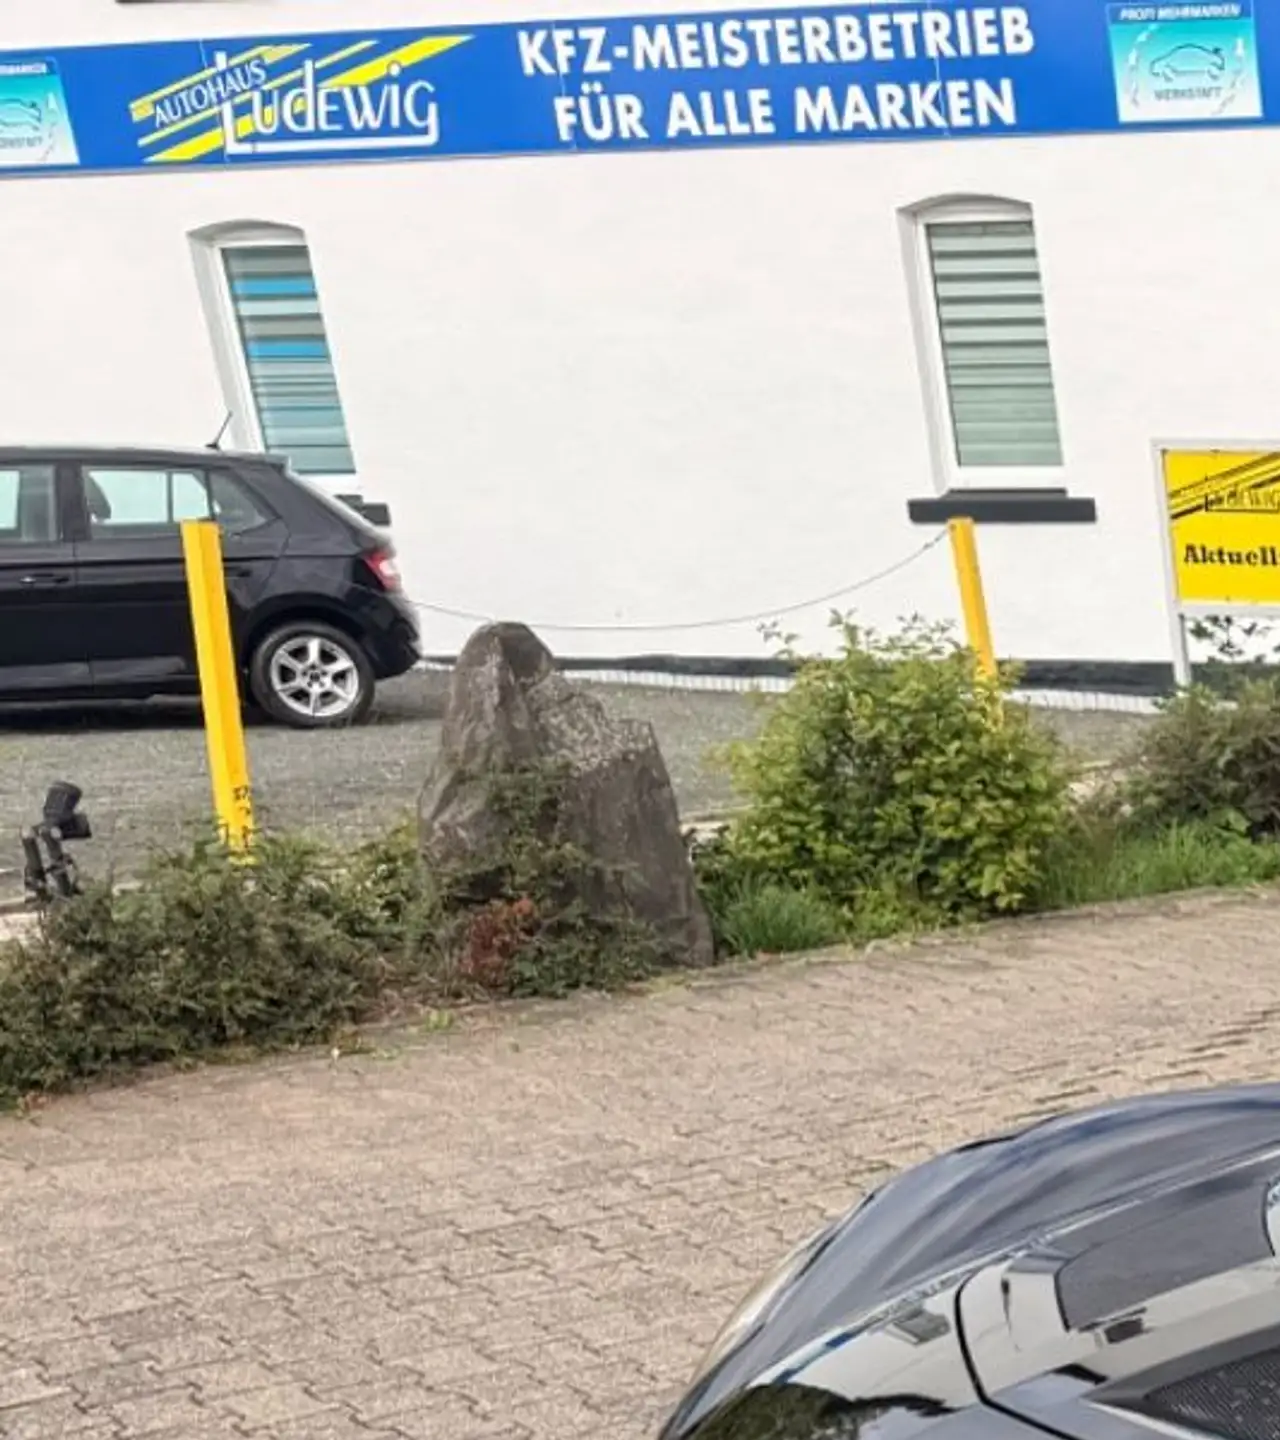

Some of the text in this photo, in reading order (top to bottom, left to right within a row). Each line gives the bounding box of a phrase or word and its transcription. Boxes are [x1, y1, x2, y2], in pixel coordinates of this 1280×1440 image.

[517, 7, 1034, 76] KFZ-MEISTERBETRIEB
[154, 58, 267, 128] AUTOHAUS
[553, 78, 1017, 142] FÜR ALLE MARKEN
